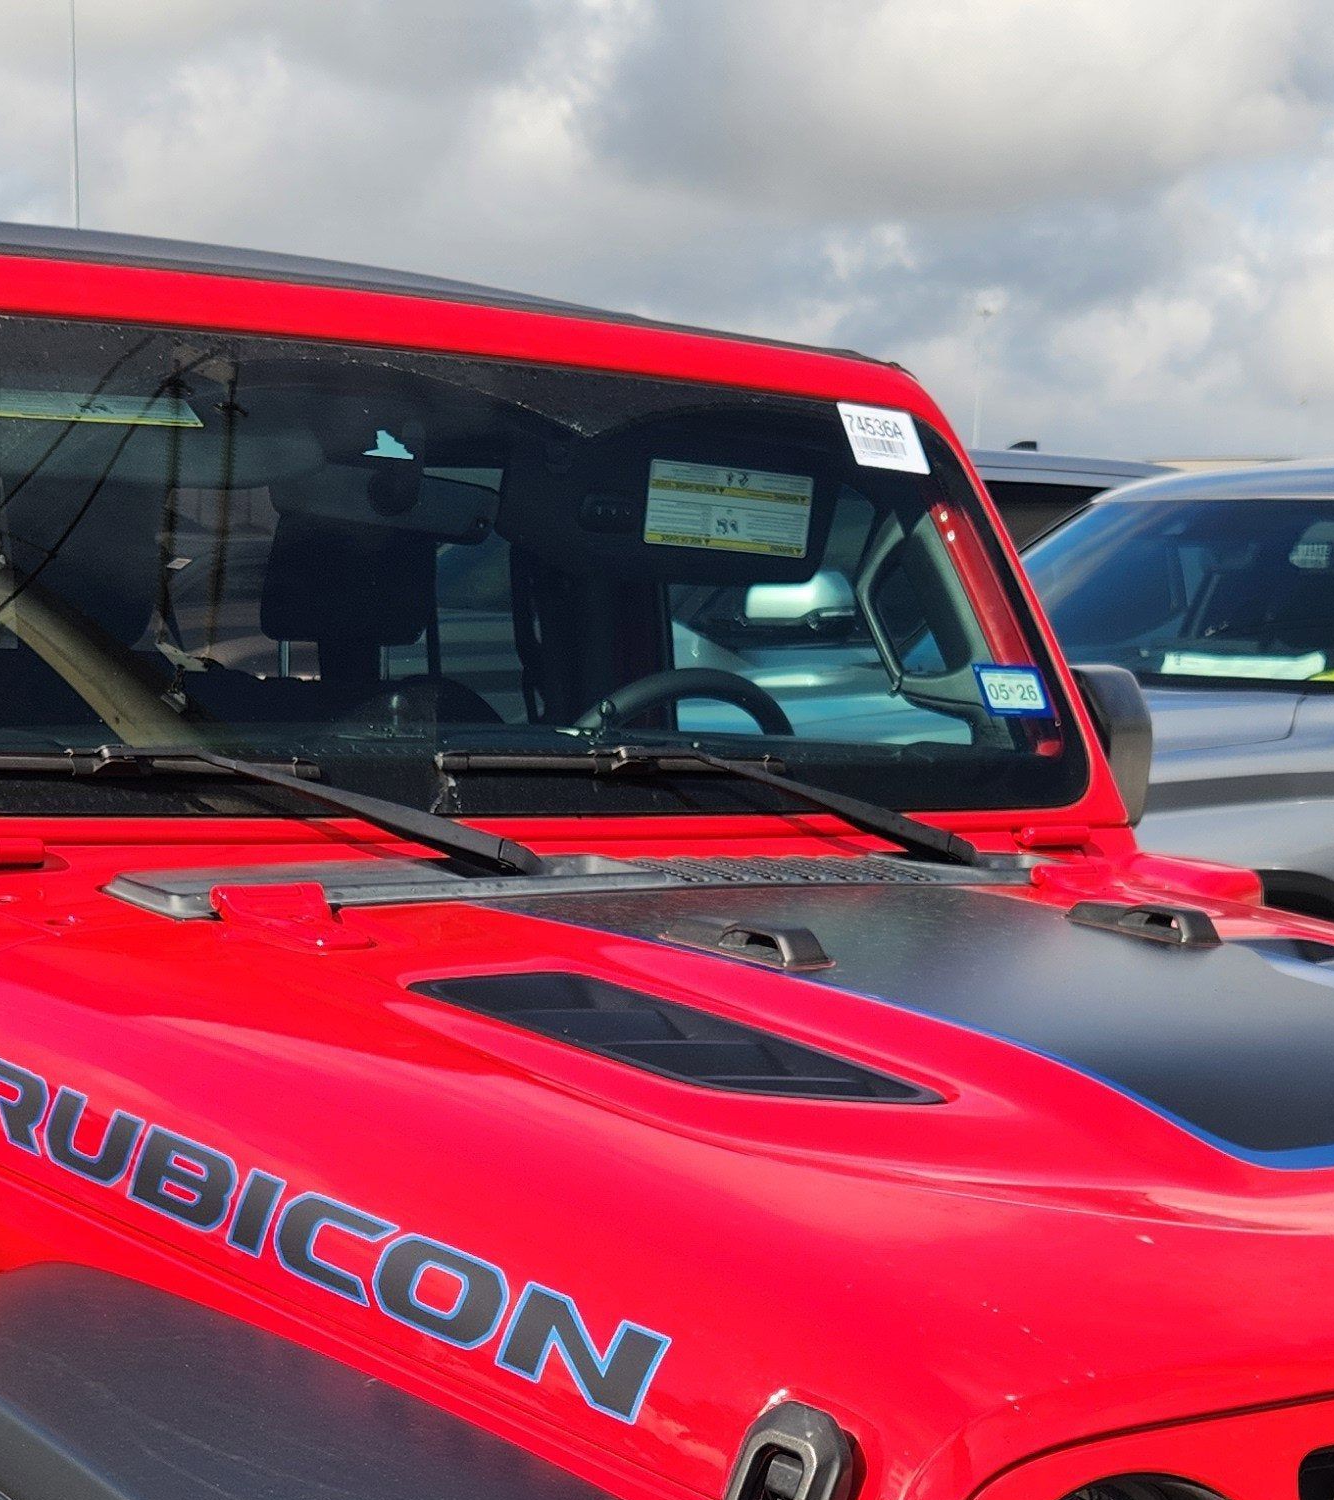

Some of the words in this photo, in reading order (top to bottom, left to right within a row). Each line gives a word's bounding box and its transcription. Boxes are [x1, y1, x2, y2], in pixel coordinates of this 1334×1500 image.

[843, 413, 905, 440] 74536A
[988, 683, 1009, 700] 05
[1016, 684, 1038, 701] 26
